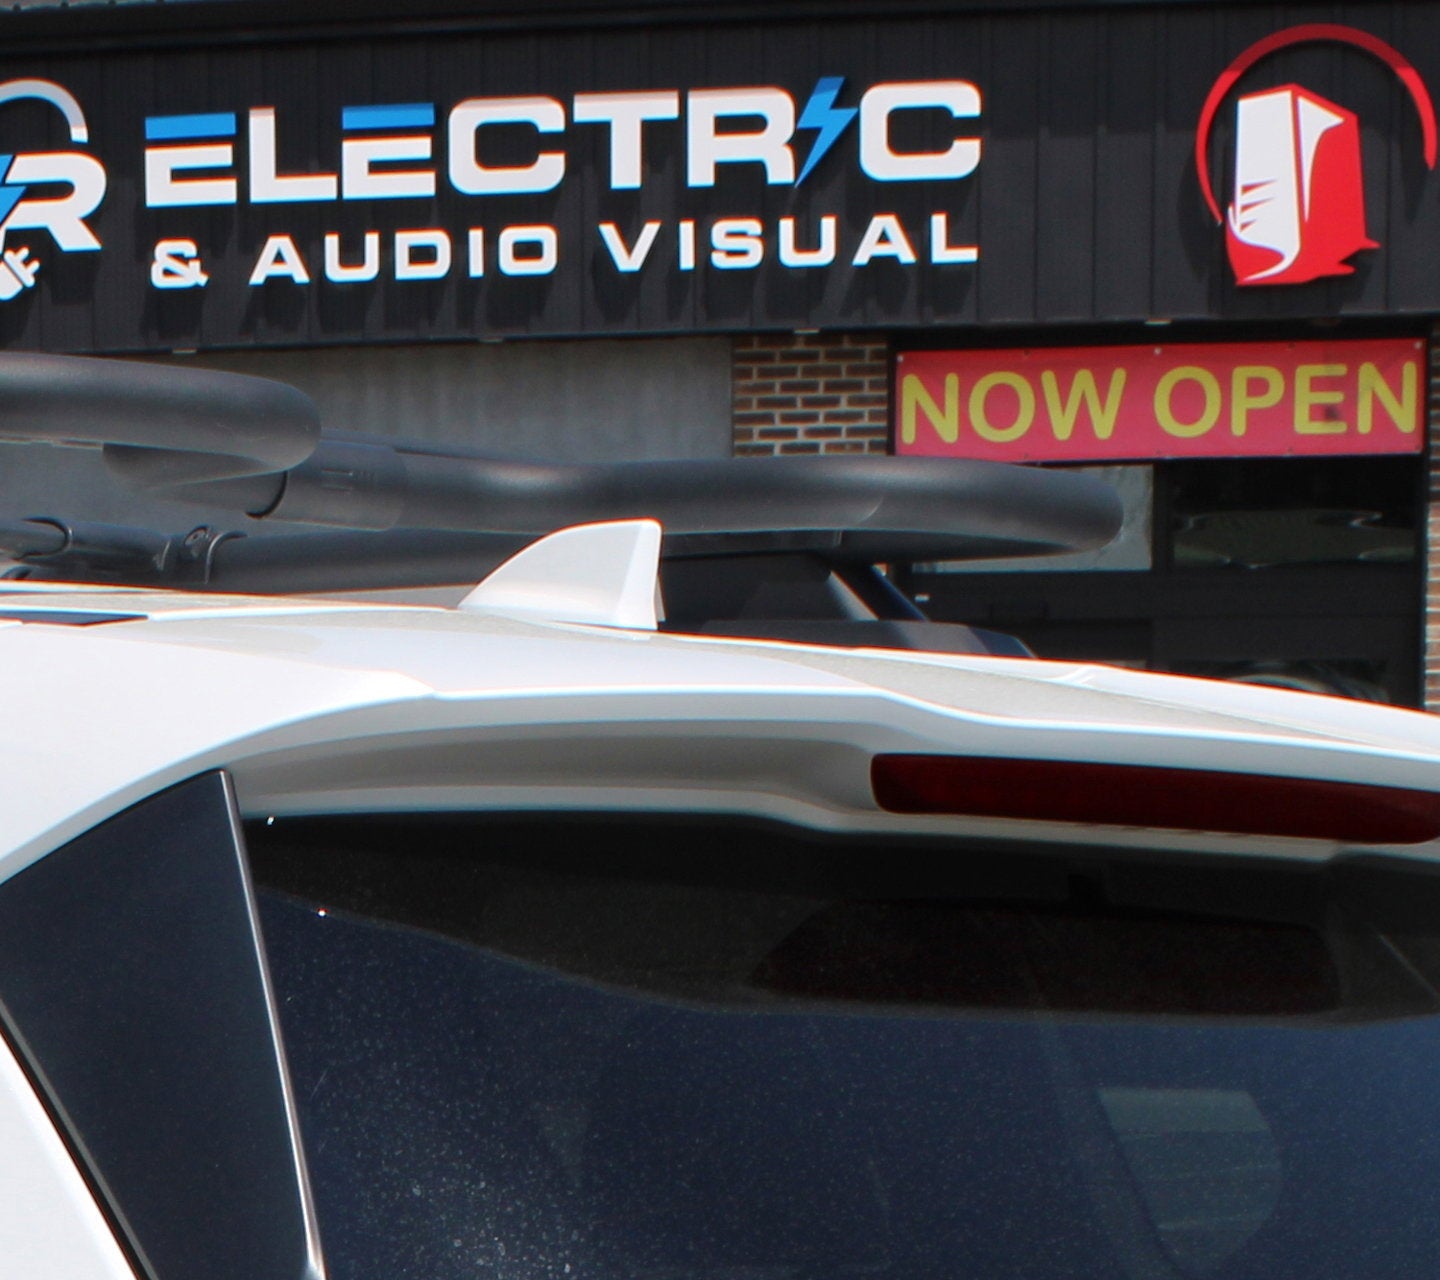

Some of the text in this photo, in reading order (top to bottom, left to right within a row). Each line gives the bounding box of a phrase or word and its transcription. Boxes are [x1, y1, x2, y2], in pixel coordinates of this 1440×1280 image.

[145, 77, 982, 208] ELECTRIC
[150, 211, 979, 289] & AUDIO VISUAL
[901, 362, 1417, 445] NOW OPEN
